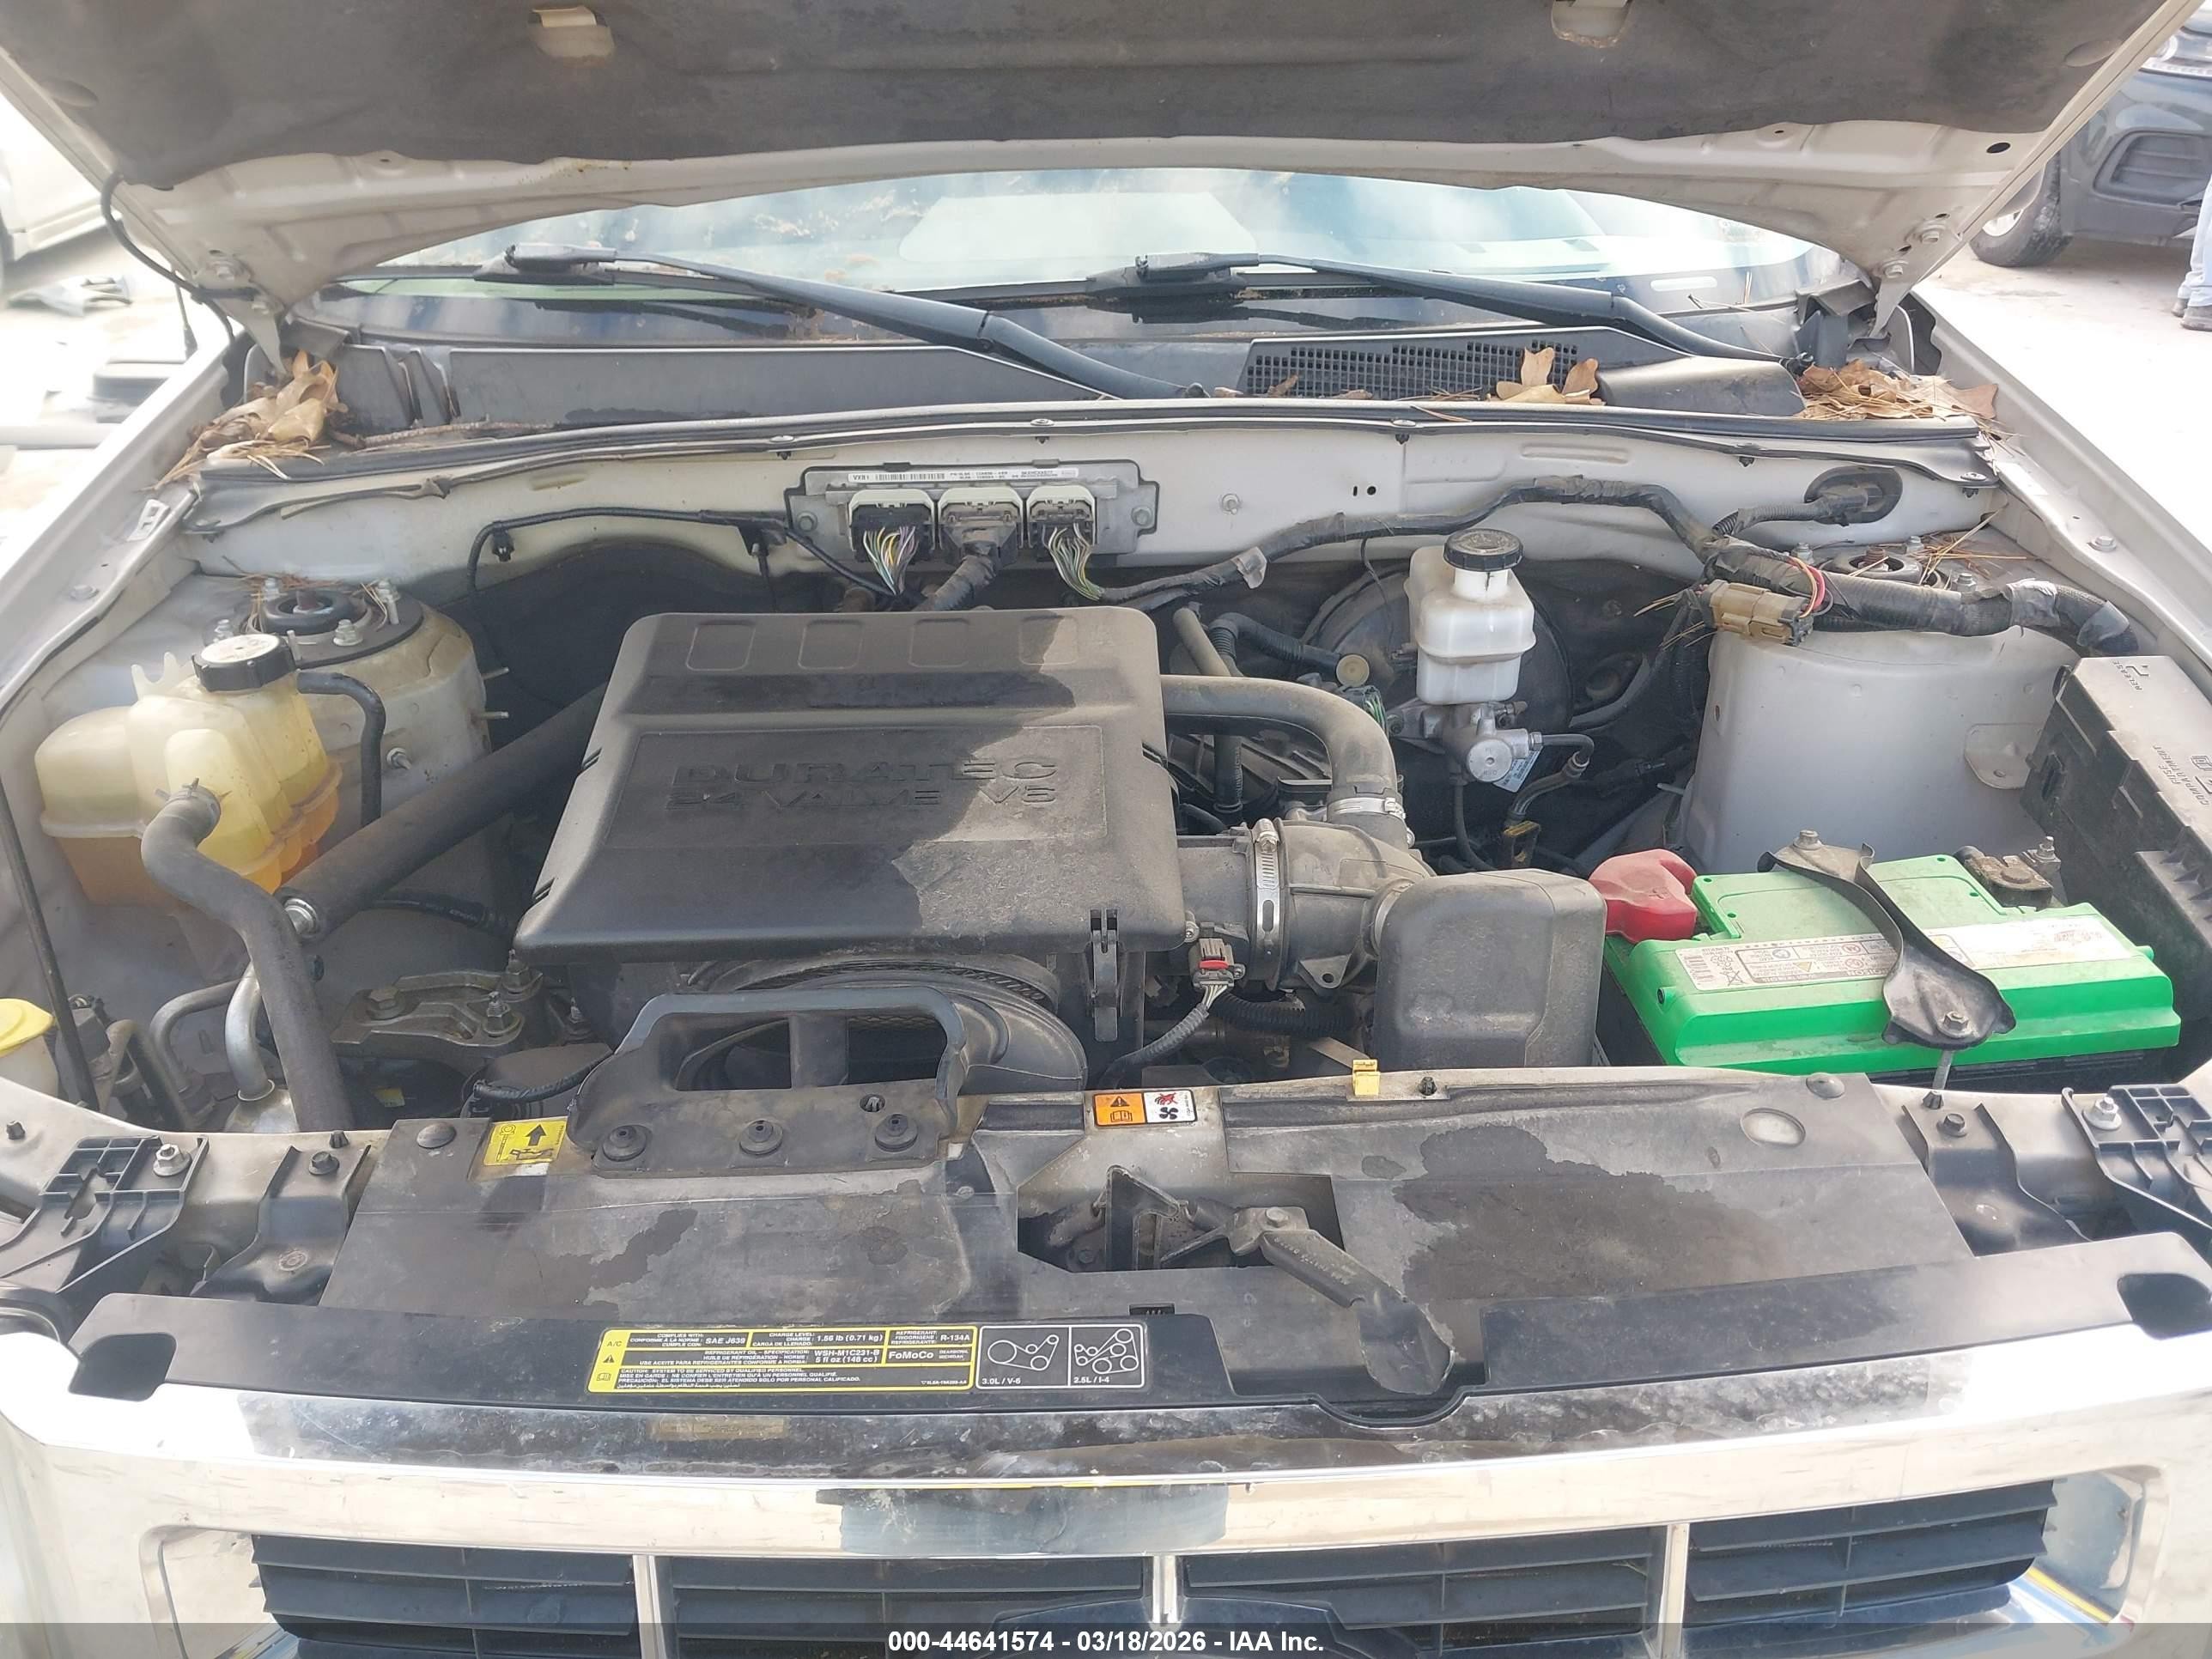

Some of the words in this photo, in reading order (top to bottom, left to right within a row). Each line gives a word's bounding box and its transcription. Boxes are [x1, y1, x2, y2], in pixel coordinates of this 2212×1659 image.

[2112, 660, 2143, 691] RELEASE
[672, 759, 1058, 785] DURATEC
[2152, 744, 2209, 806] COMPARTMENT
[2158, 764, 2182, 786] FUSE
[665, 787, 742, 811] 24
[761, 787, 941, 810] VALVE
[845, 1334, 866, 1342] (0.71
[868, 1334, 883, 1343] kg)
[888, 1351, 934, 1359] FoMoCo
